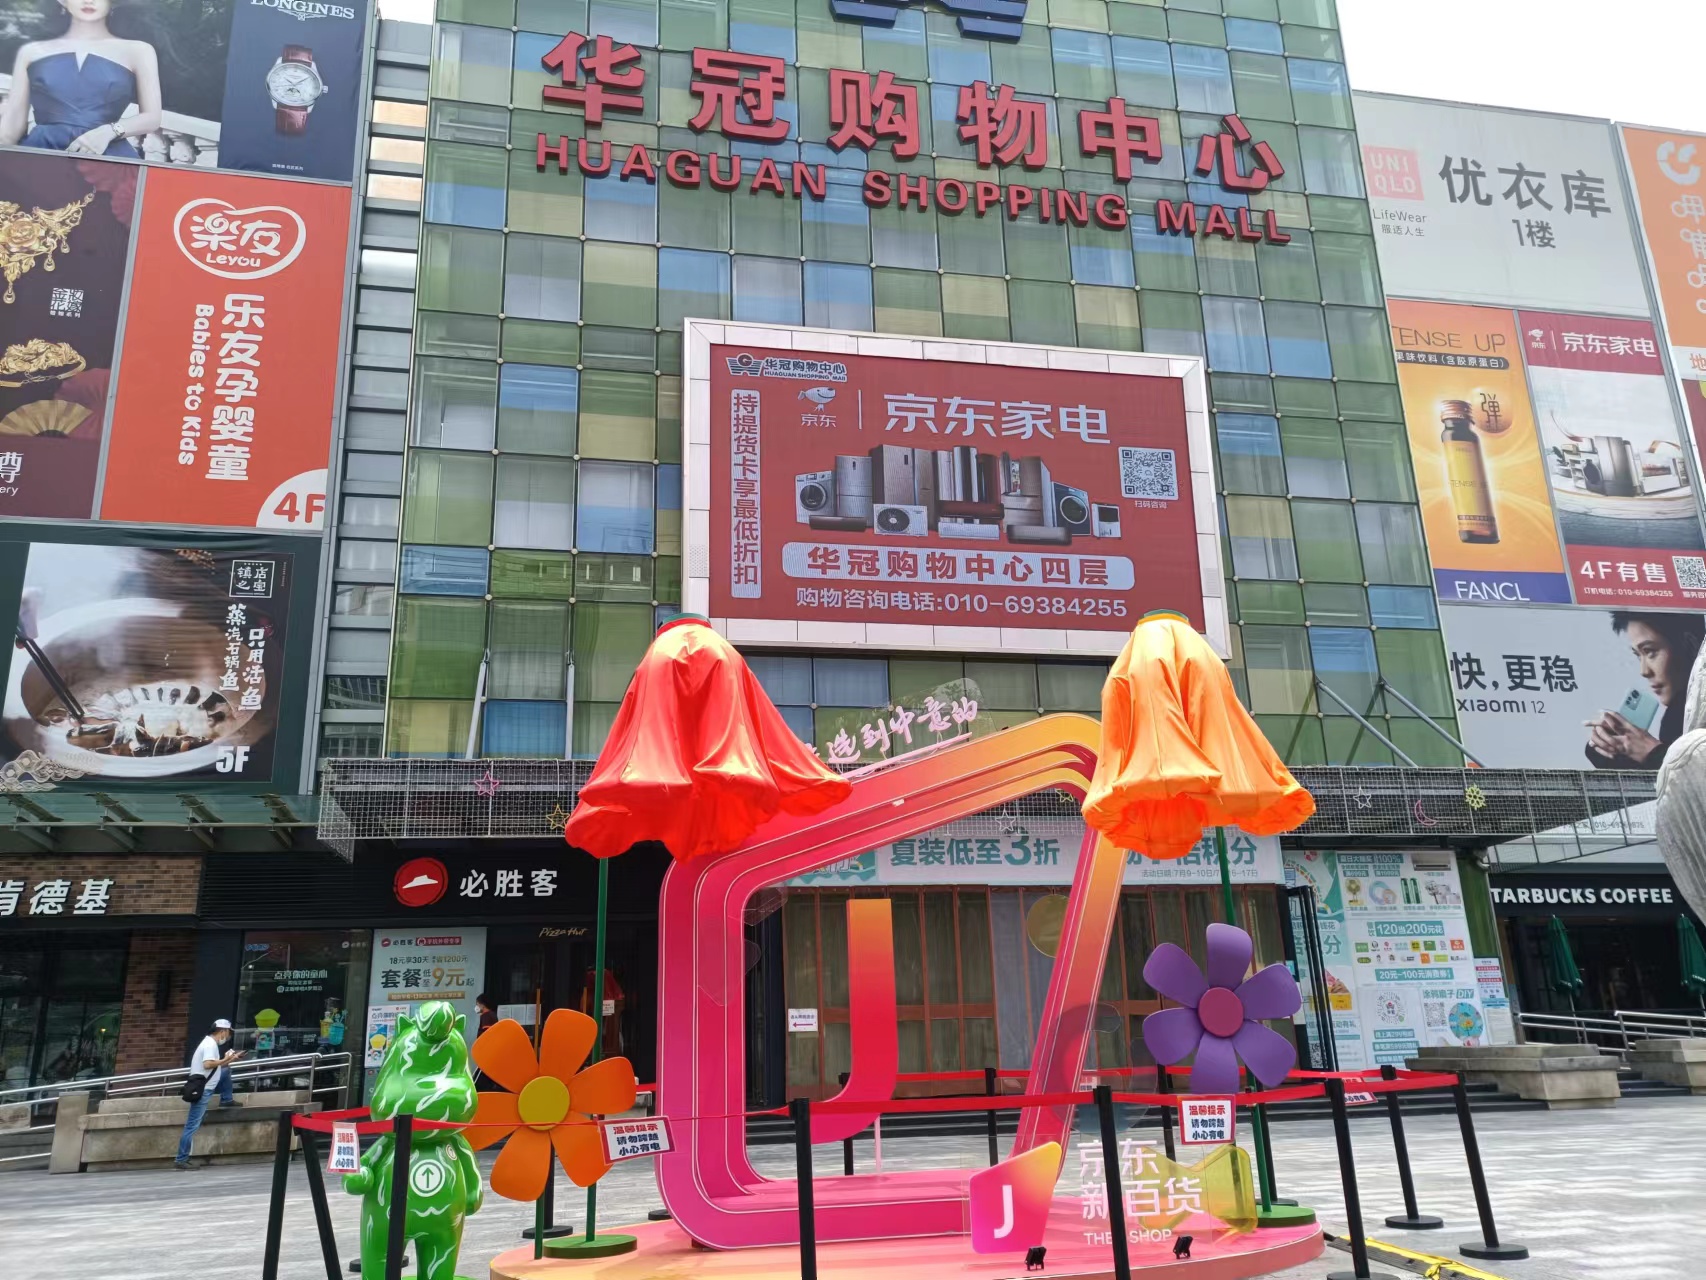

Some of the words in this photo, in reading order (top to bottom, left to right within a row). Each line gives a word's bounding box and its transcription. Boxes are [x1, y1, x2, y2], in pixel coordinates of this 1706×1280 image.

[541, 31, 1285, 193] 华冠购物中心
[1369, 150, 1411, 172] UNI
[535, 132, 827, 202] HUAGUAN
[863, 169, 1128, 231] SHOPPING
[1155, 198, 1292, 244] MALL
[1438, 154, 1611, 219] 优衣库
[1372, 207, 1428, 224] LifeWear
[1380, 223, 1426, 237] 服适人生
[1511, 217, 1557, 249] 1楼
[205, 252, 262, 268] Leyou
[187, 303, 215, 379] Babies
[1391, 325, 1463, 348] ENSE
[1474, 332, 1506, 353] UP
[1561, 331, 1657, 358] 京东家电
[764, 357, 846, 376] 华冠购物中心
[764, 370, 798, 379] HUAGUAN
[797, 372, 830, 380] SHOPPING
[183, 382, 205, 412] to
[204, 293, 266, 481] 乐友孕婴童
[800, 413, 837, 428] 京东
[883, 392, 1111, 444] 京东家电
[177, 415, 201, 467] Kids
[733, 393, 759, 585] 持提货卡享最低折扣
[273, 491, 327, 523] 4F
[1134, 500, 1168, 509] 扫码咨询
[807, 546, 1110, 587] 华冠购物中心四层
[1580, 560, 1668, 584] 4F有售
[796, 586, 1128, 617] 购物咨询电话:010-69384255
[1454, 580, 1530, 602] FANCL
[219, 603, 247, 691] 蒸汽石锅鱼
[237, 628, 267, 711] 只用活鱼
[1456, 698, 1527, 714] xiaomi
[1530, 700, 1547, 714] 12
[215, 745, 251, 774] 5F
[890, 826, 1060, 866] 夏装低至3折
[459, 868, 558, 897] 必胜客
[1600, 887, 1673, 904] COFFEE
[0, 878, 114, 916] 肯德基
[538, 927, 566, 938] Pizza
[566, 927, 588, 937] Hut
[1377, 923, 1443, 935] 120当200元花
[1457, 990, 1474, 998] DIY
[1188, 1104, 1226, 1116] 温馨提示
[1191, 1118, 1225, 1128] 请勿跨越
[613, 1123, 659, 1135] 温馨提示
[616, 1132, 660, 1146] 请勿跨越
[1192, 1130, 1225, 1140] 小心有电
[618, 1142, 661, 1157] 小心有电
[1077, 1138, 1160, 1178] 京东
[993, 1184, 1014, 1239] J
[1080, 1176, 1205, 1220] 新百货
[1083, 1231, 1113, 1246] THE
[1129, 1228, 1173, 1244] SHOP
